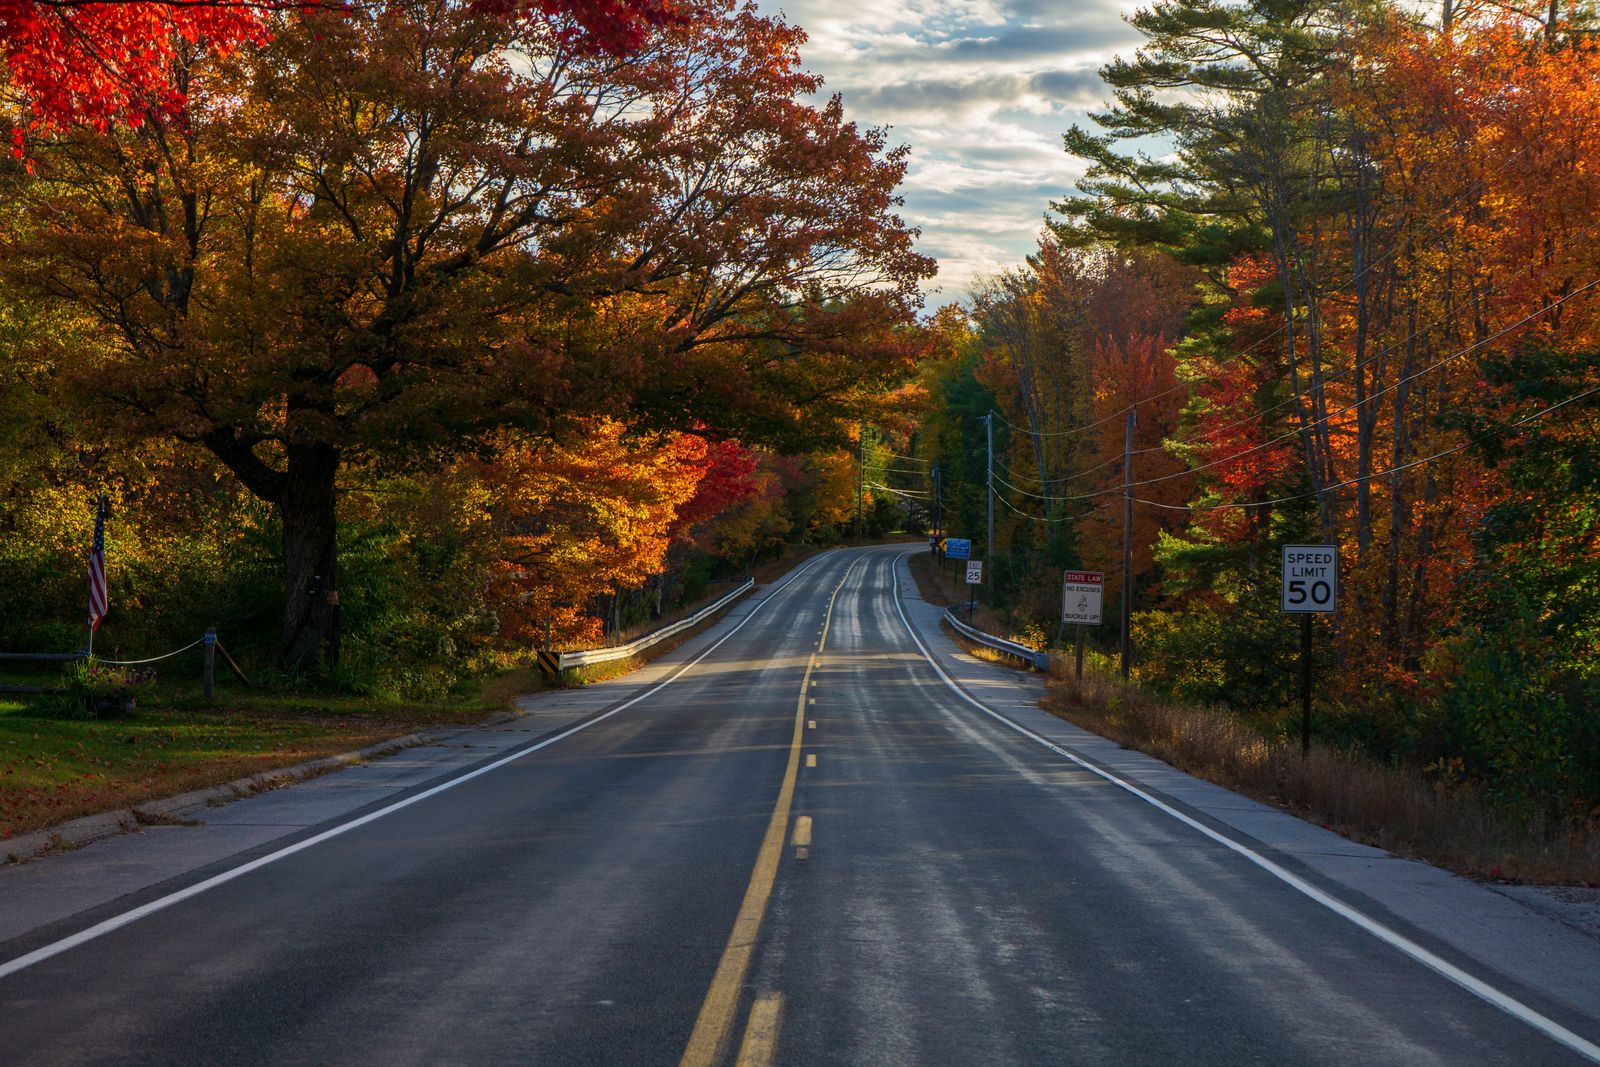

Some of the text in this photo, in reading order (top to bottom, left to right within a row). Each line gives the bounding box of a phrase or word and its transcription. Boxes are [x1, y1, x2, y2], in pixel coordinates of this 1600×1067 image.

[1287, 553, 1332, 564] SPEED
[968, 571, 980, 581] 25
[1292, 567, 1327, 577] LIMIT
[1067, 574, 1086, 582] STATE
[1288, 580, 1331, 605] 50
